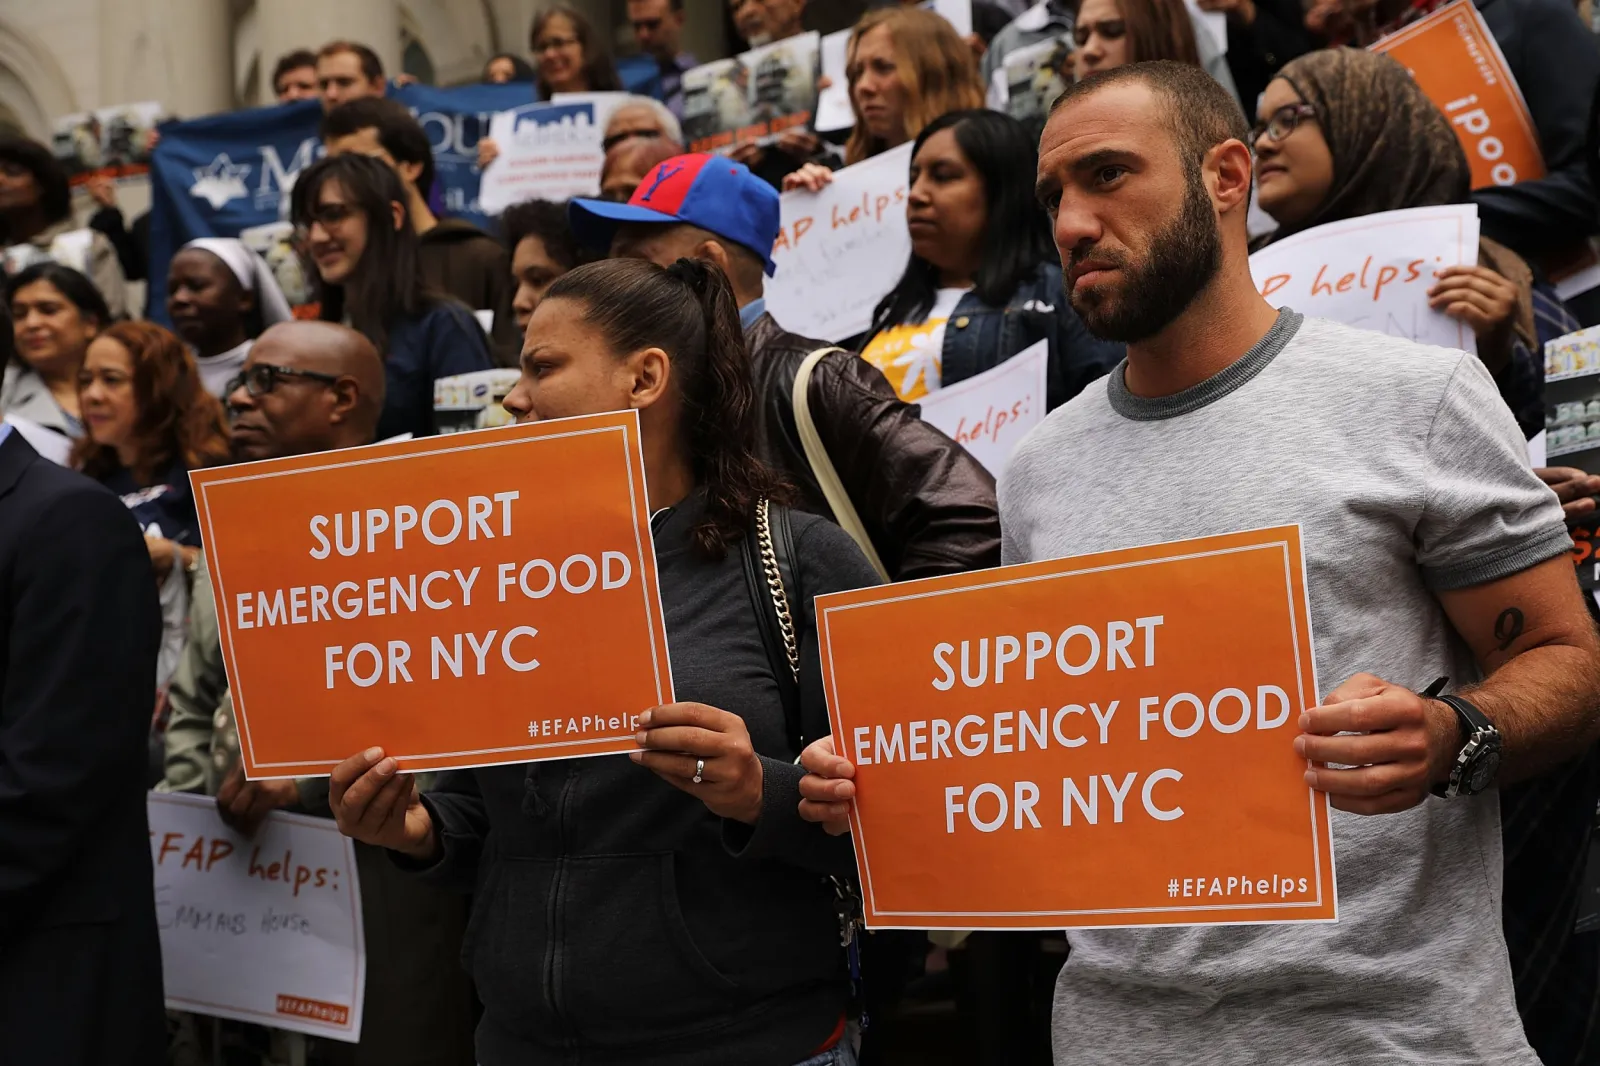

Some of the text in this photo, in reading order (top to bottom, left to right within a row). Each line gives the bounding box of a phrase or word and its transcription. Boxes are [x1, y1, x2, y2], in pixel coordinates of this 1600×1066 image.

[1444, 94, 1517, 187] ood!
[772, 216, 814, 254] AP
[1311, 256, 1443, 301] helps:
[309, 491, 520, 560] SUPPORT
[236, 551, 632, 629] EMERGENCY FOOD
[324, 625, 540, 689] FOR NYC
[931, 615, 1164, 691] SUPPORT
[527, 711, 641, 737] #EFAPhelp
[853, 684, 1290, 765] EMERGENCY FOOD
[945, 768, 1184, 833] FOR NYC
[248, 850, 340, 897] helps:
[1168, 875, 1308, 899] #EFAPhelps
